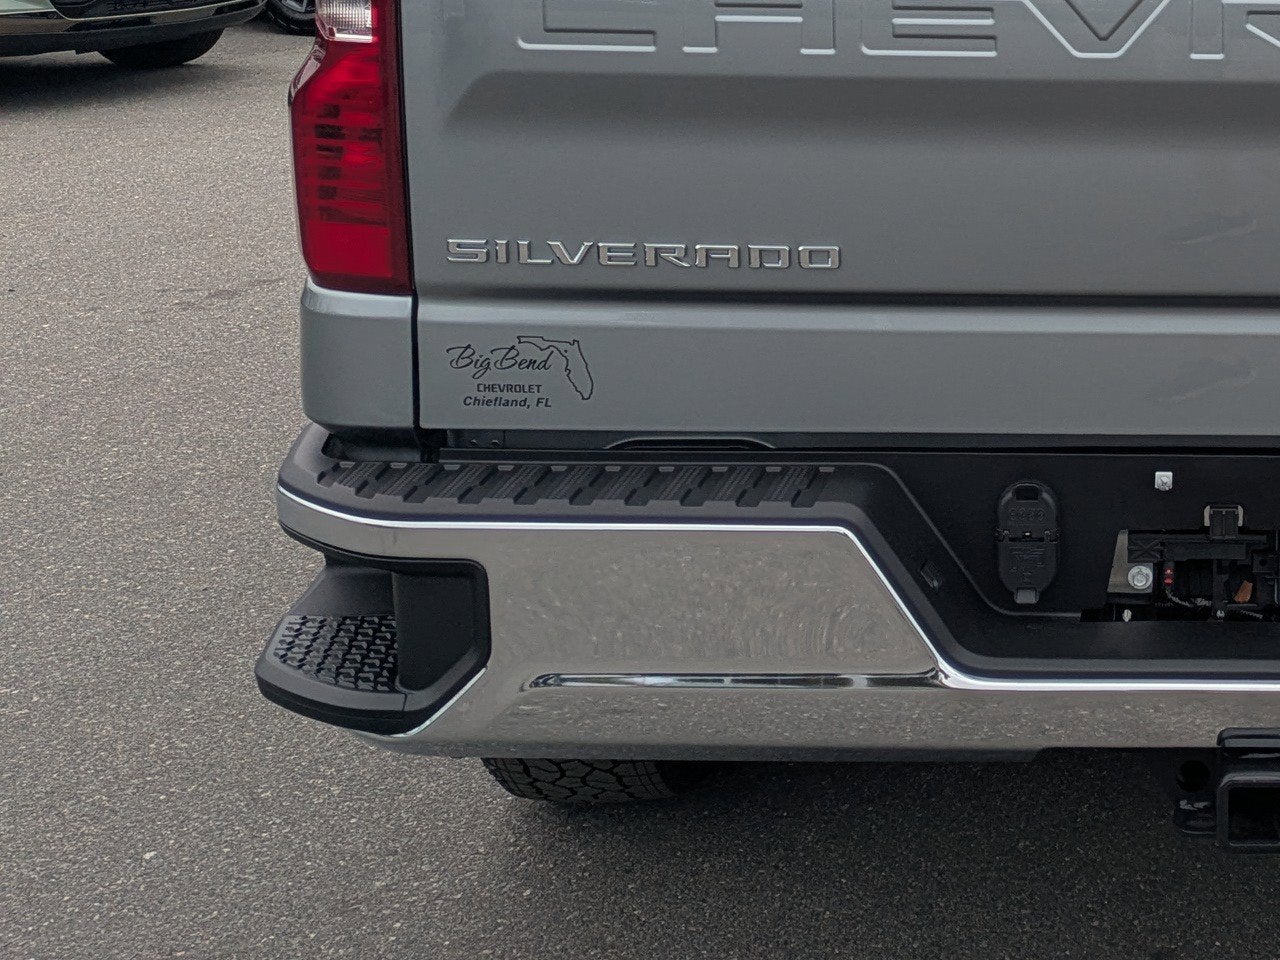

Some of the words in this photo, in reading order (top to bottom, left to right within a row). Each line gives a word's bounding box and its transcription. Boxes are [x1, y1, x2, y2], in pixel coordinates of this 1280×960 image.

[446, 238, 842, 270] SILVERADO
[446, 343, 492, 380] Big
[490, 344, 554, 372] Bend
[476, 382, 543, 394] CHEVROLET
[463, 395, 531, 410] Chiefland,
[535, 397, 552, 408] FL
